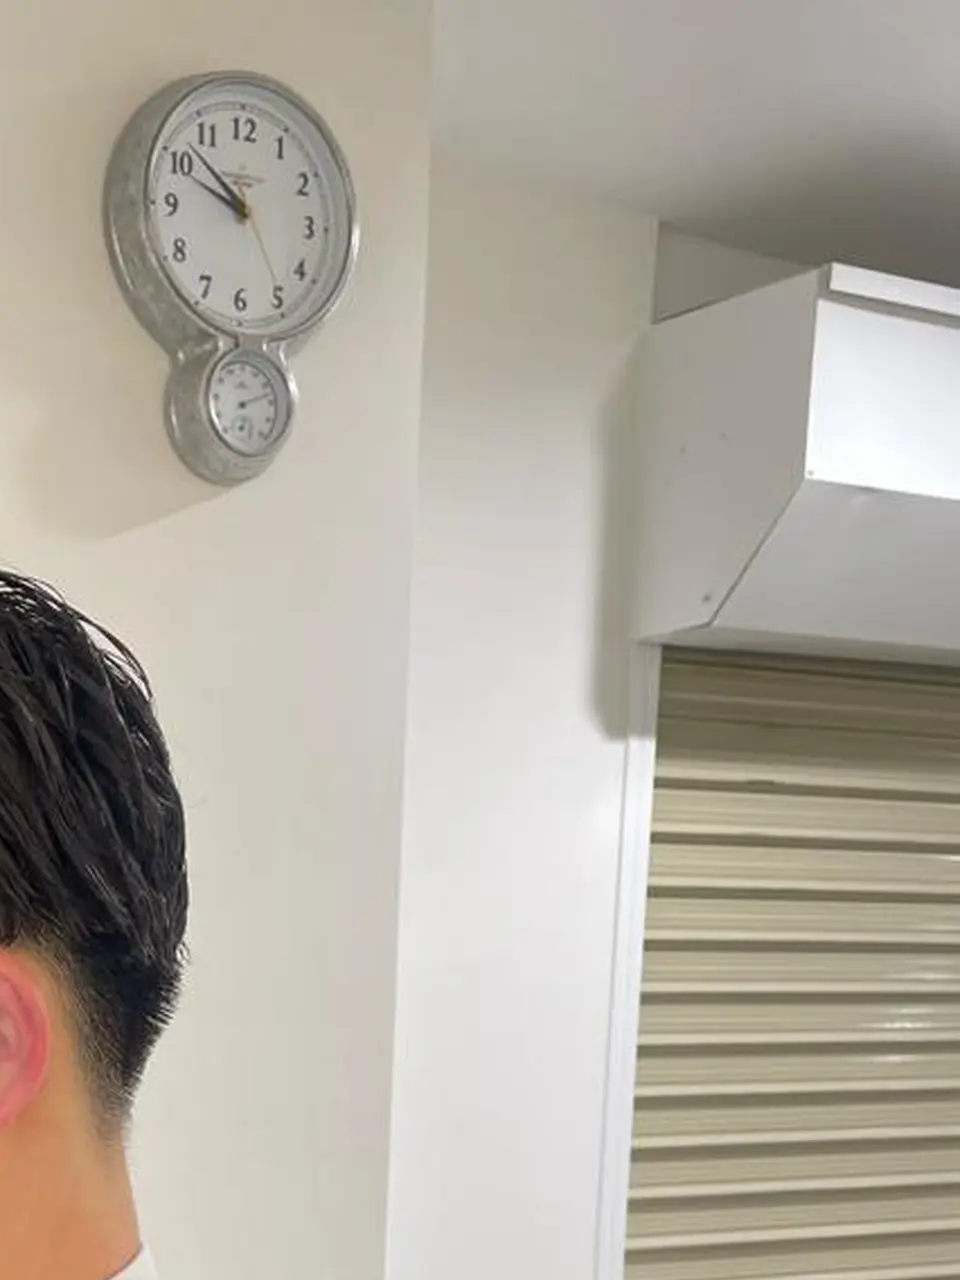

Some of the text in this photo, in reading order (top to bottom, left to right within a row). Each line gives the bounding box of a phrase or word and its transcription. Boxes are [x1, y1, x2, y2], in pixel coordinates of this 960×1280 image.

[197, 122, 216, 147] 11
[231, 117, 257, 143] 12
[275, 136, 284, 160] 1
[171, 151, 193, 176] 10
[296, 173, 309, 197] 2
[163, 193, 178, 217] 9
[302, 216, 315, 240] 3
[172, 238, 186, 263] 8
[293, 258, 307, 281] 4
[198, 275, 212, 299] 7
[271, 286, 284, 309] 5
[233, 289, 248, 311] 6
